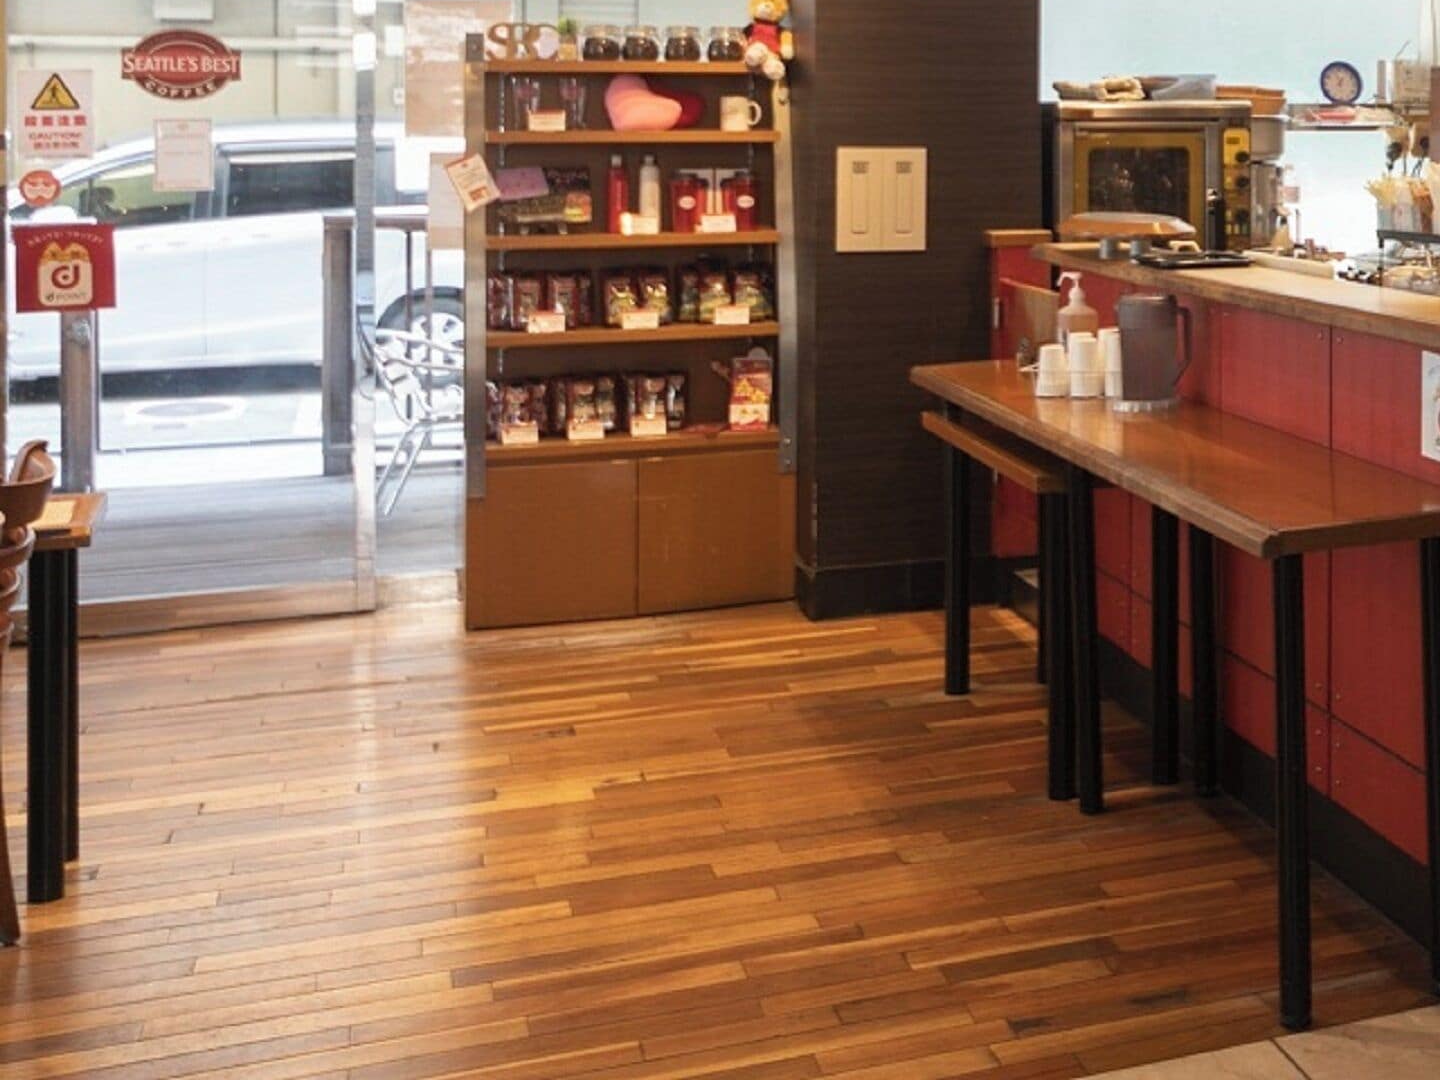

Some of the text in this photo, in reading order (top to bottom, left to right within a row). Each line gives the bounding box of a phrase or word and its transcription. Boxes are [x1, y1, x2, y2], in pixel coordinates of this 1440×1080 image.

[124, 53, 239, 73] SEATTLE'S BEST
[146, 81, 217, 98] COFFEE
